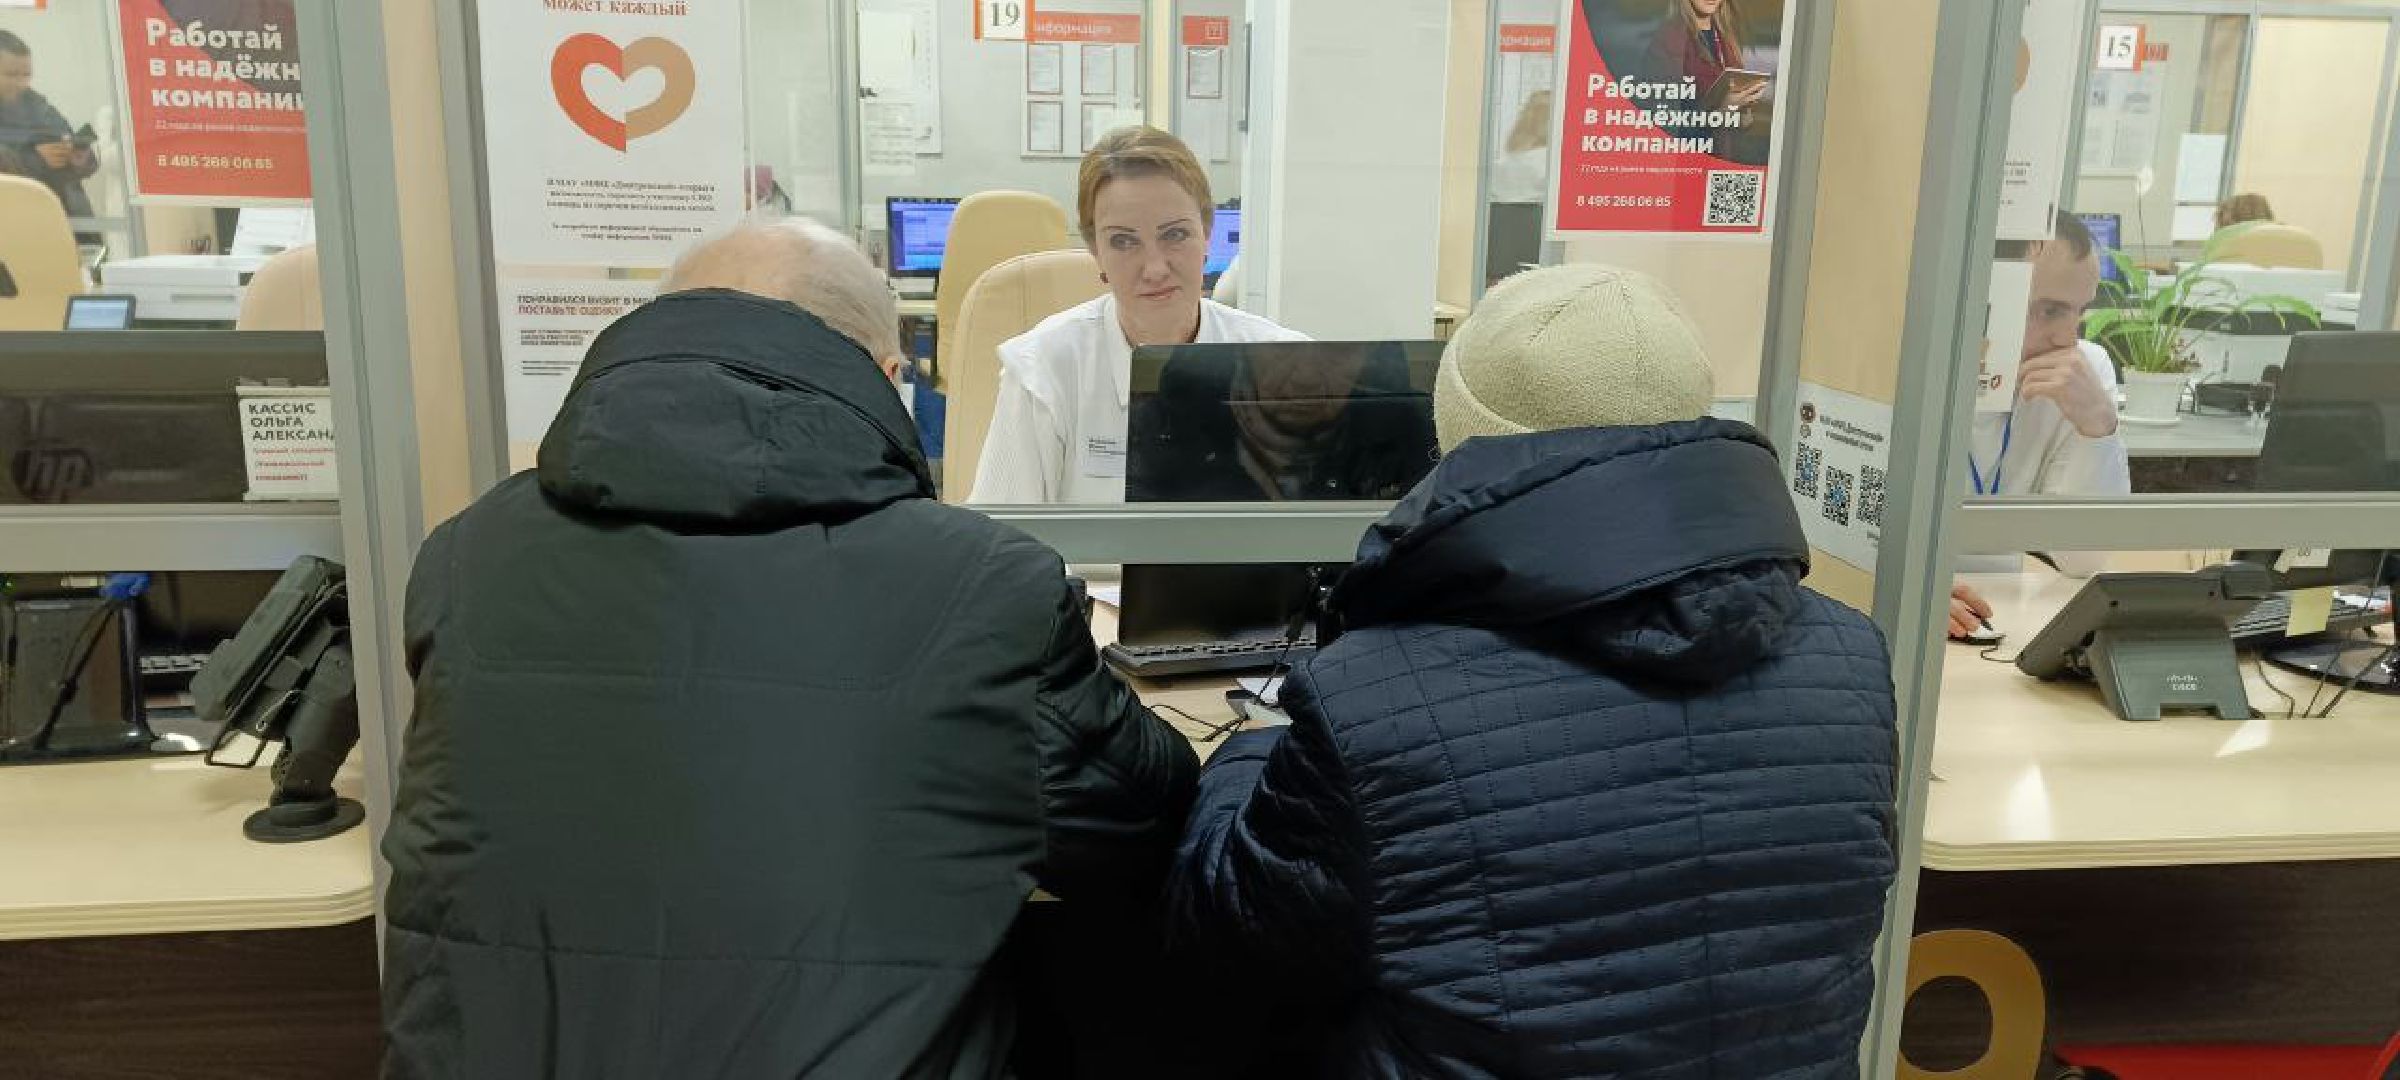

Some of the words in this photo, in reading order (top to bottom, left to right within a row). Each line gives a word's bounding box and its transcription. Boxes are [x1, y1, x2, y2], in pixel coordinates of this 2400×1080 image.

[610, 1, 687, 15] каждый
[991, 2, 1019, 27] 19
[146, 18, 282, 50] Работай
[2107, 35, 2131, 57] 15
[150, 59, 167, 76] в
[175, 53, 301, 82] надёжн
[1587, 73, 1697, 100] Работай
[1584, 108, 1599, 124] в
[1605, 104, 1741, 130] надёжной
[1582, 135, 1714, 154] компании
[1588, 195, 1611, 207] 495
[248, 403, 316, 415] КАССИС
[250, 416, 304, 428] ОЛЬГА
[253, 429, 335, 441] АЛЕКСАН
